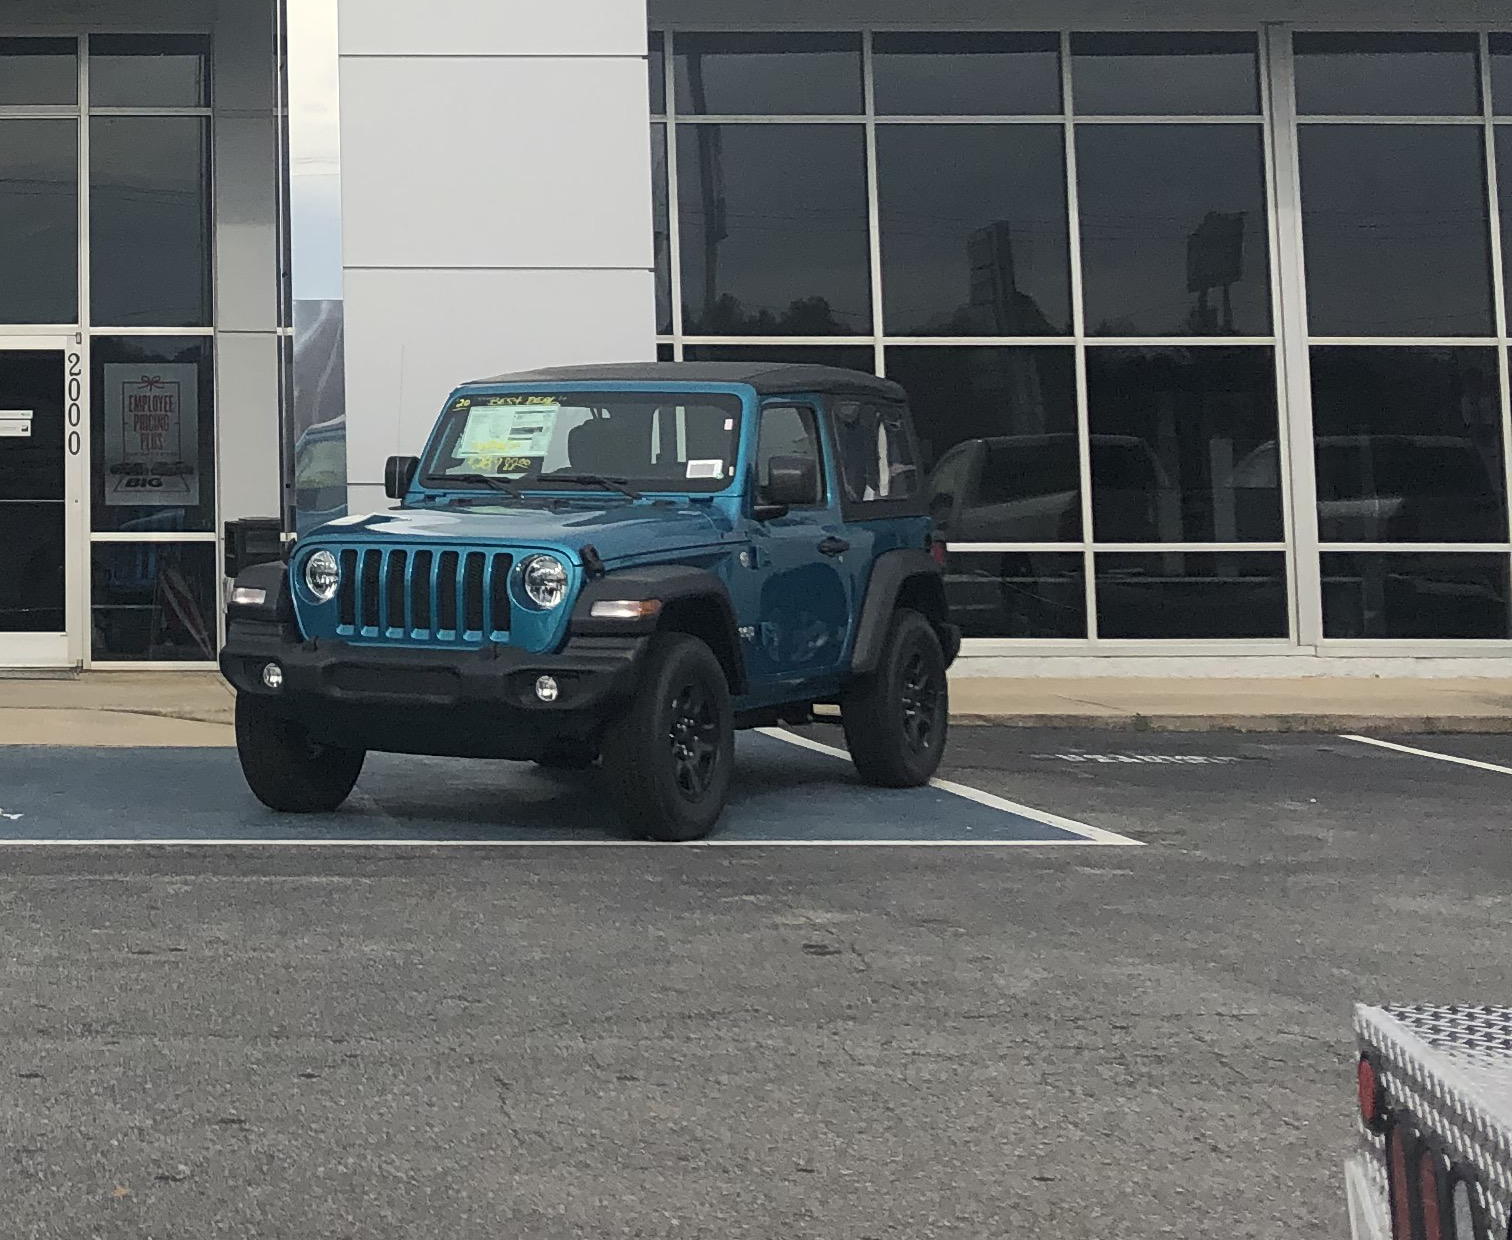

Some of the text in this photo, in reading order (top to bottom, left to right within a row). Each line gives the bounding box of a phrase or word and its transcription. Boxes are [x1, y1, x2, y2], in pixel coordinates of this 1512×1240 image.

[67, 352, 82, 456] 2000
[128, 394, 175, 413] EMPLOYEE
[133, 414, 170, 432] PRICING
[140, 432, 164, 451] PLUS
[125, 477, 164, 489] BIG
